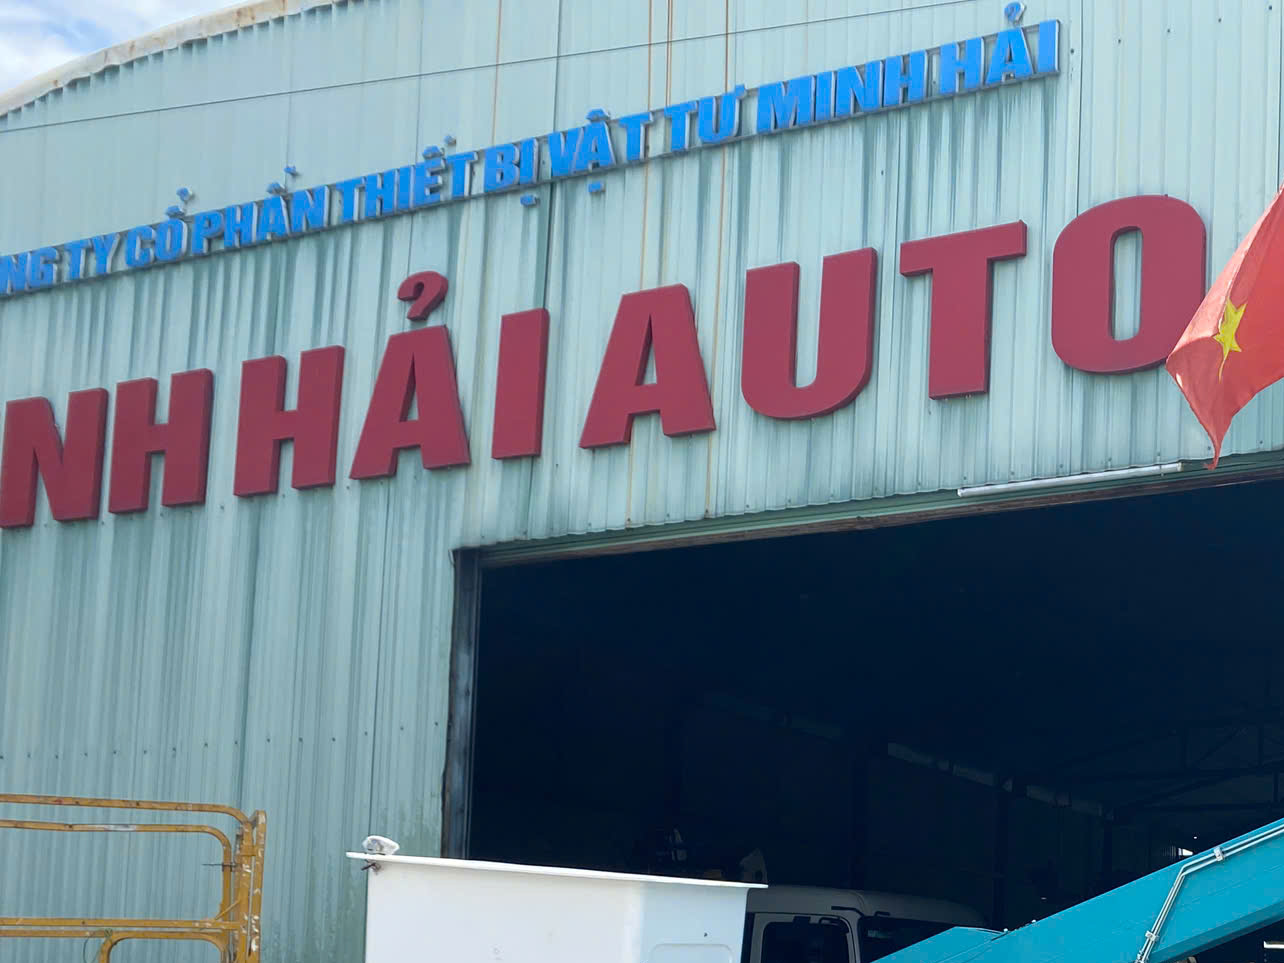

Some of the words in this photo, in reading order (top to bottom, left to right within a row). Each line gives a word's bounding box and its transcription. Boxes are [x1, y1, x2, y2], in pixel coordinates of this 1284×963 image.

[65, 233, 119, 281] TY
[125, 187, 192, 268] CỔ
[191, 165, 331, 255] PHẦN
[335, 135, 478, 222] THIẾT
[484, 138, 540, 206] BỊ
[548, 108, 653, 194] VẬT
[664, 84, 747, 150] TƯ
[756, 50, 928, 134] MINH
[939, 1, 1061, 95] HẢI
[233, 271, 550, 497] HẢI
[579, 194, 1206, 450] AUTO
